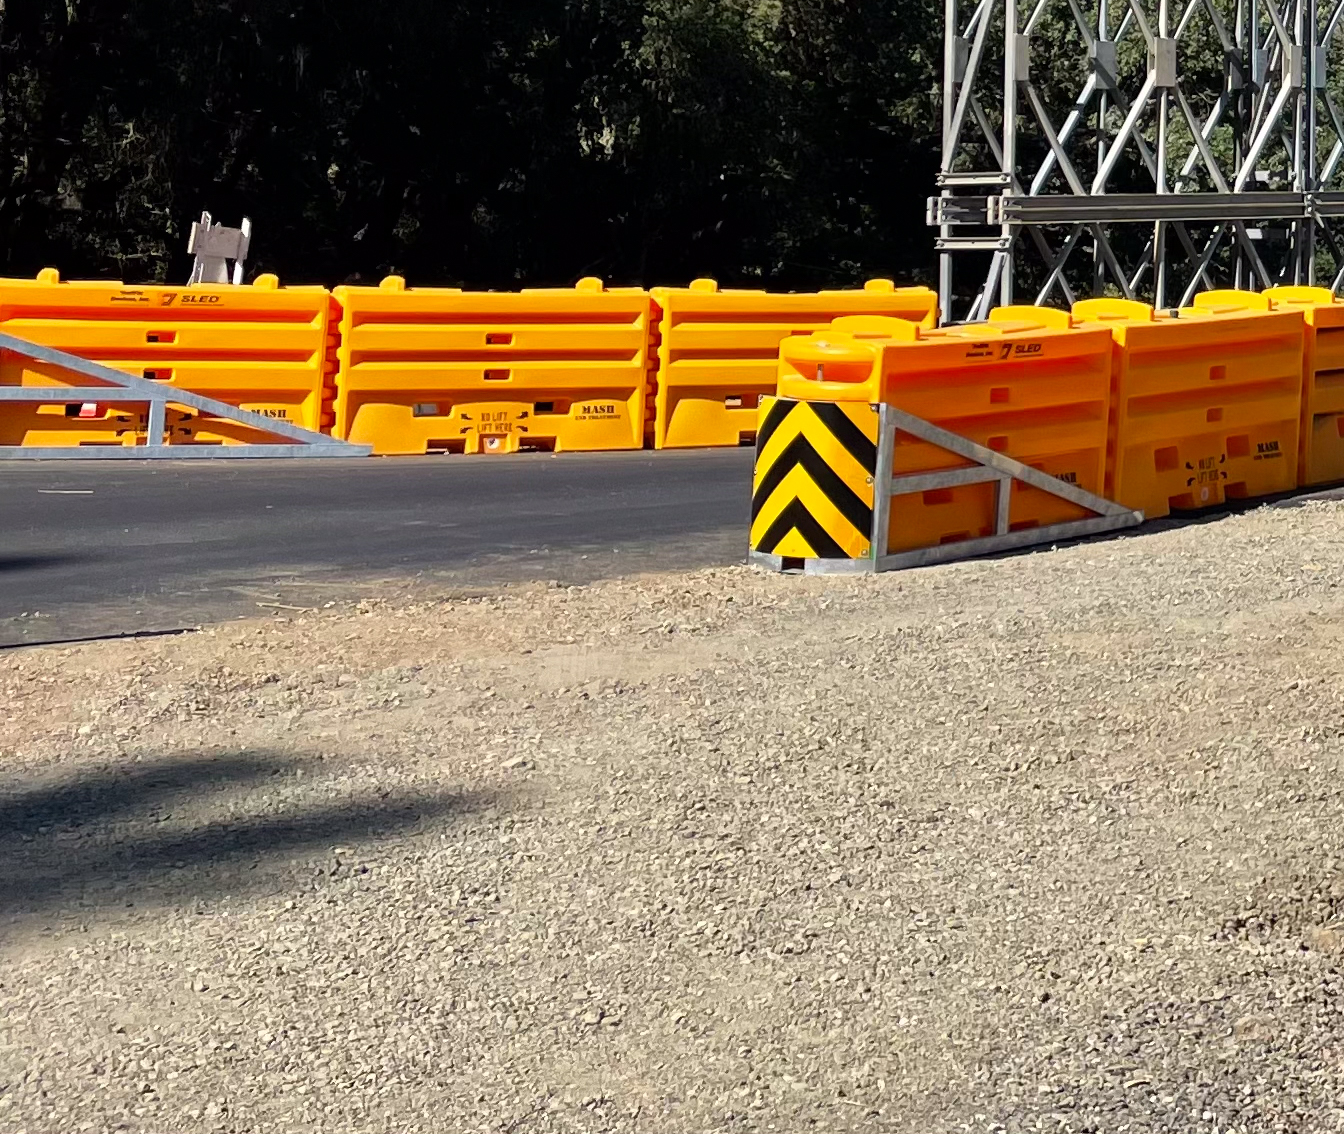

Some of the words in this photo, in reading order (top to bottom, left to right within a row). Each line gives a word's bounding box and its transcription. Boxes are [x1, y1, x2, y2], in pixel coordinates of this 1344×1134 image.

[181, 295, 219, 303] SLED
[1015, 343, 1042, 353] SLED
[582, 405, 615, 414] MASH
